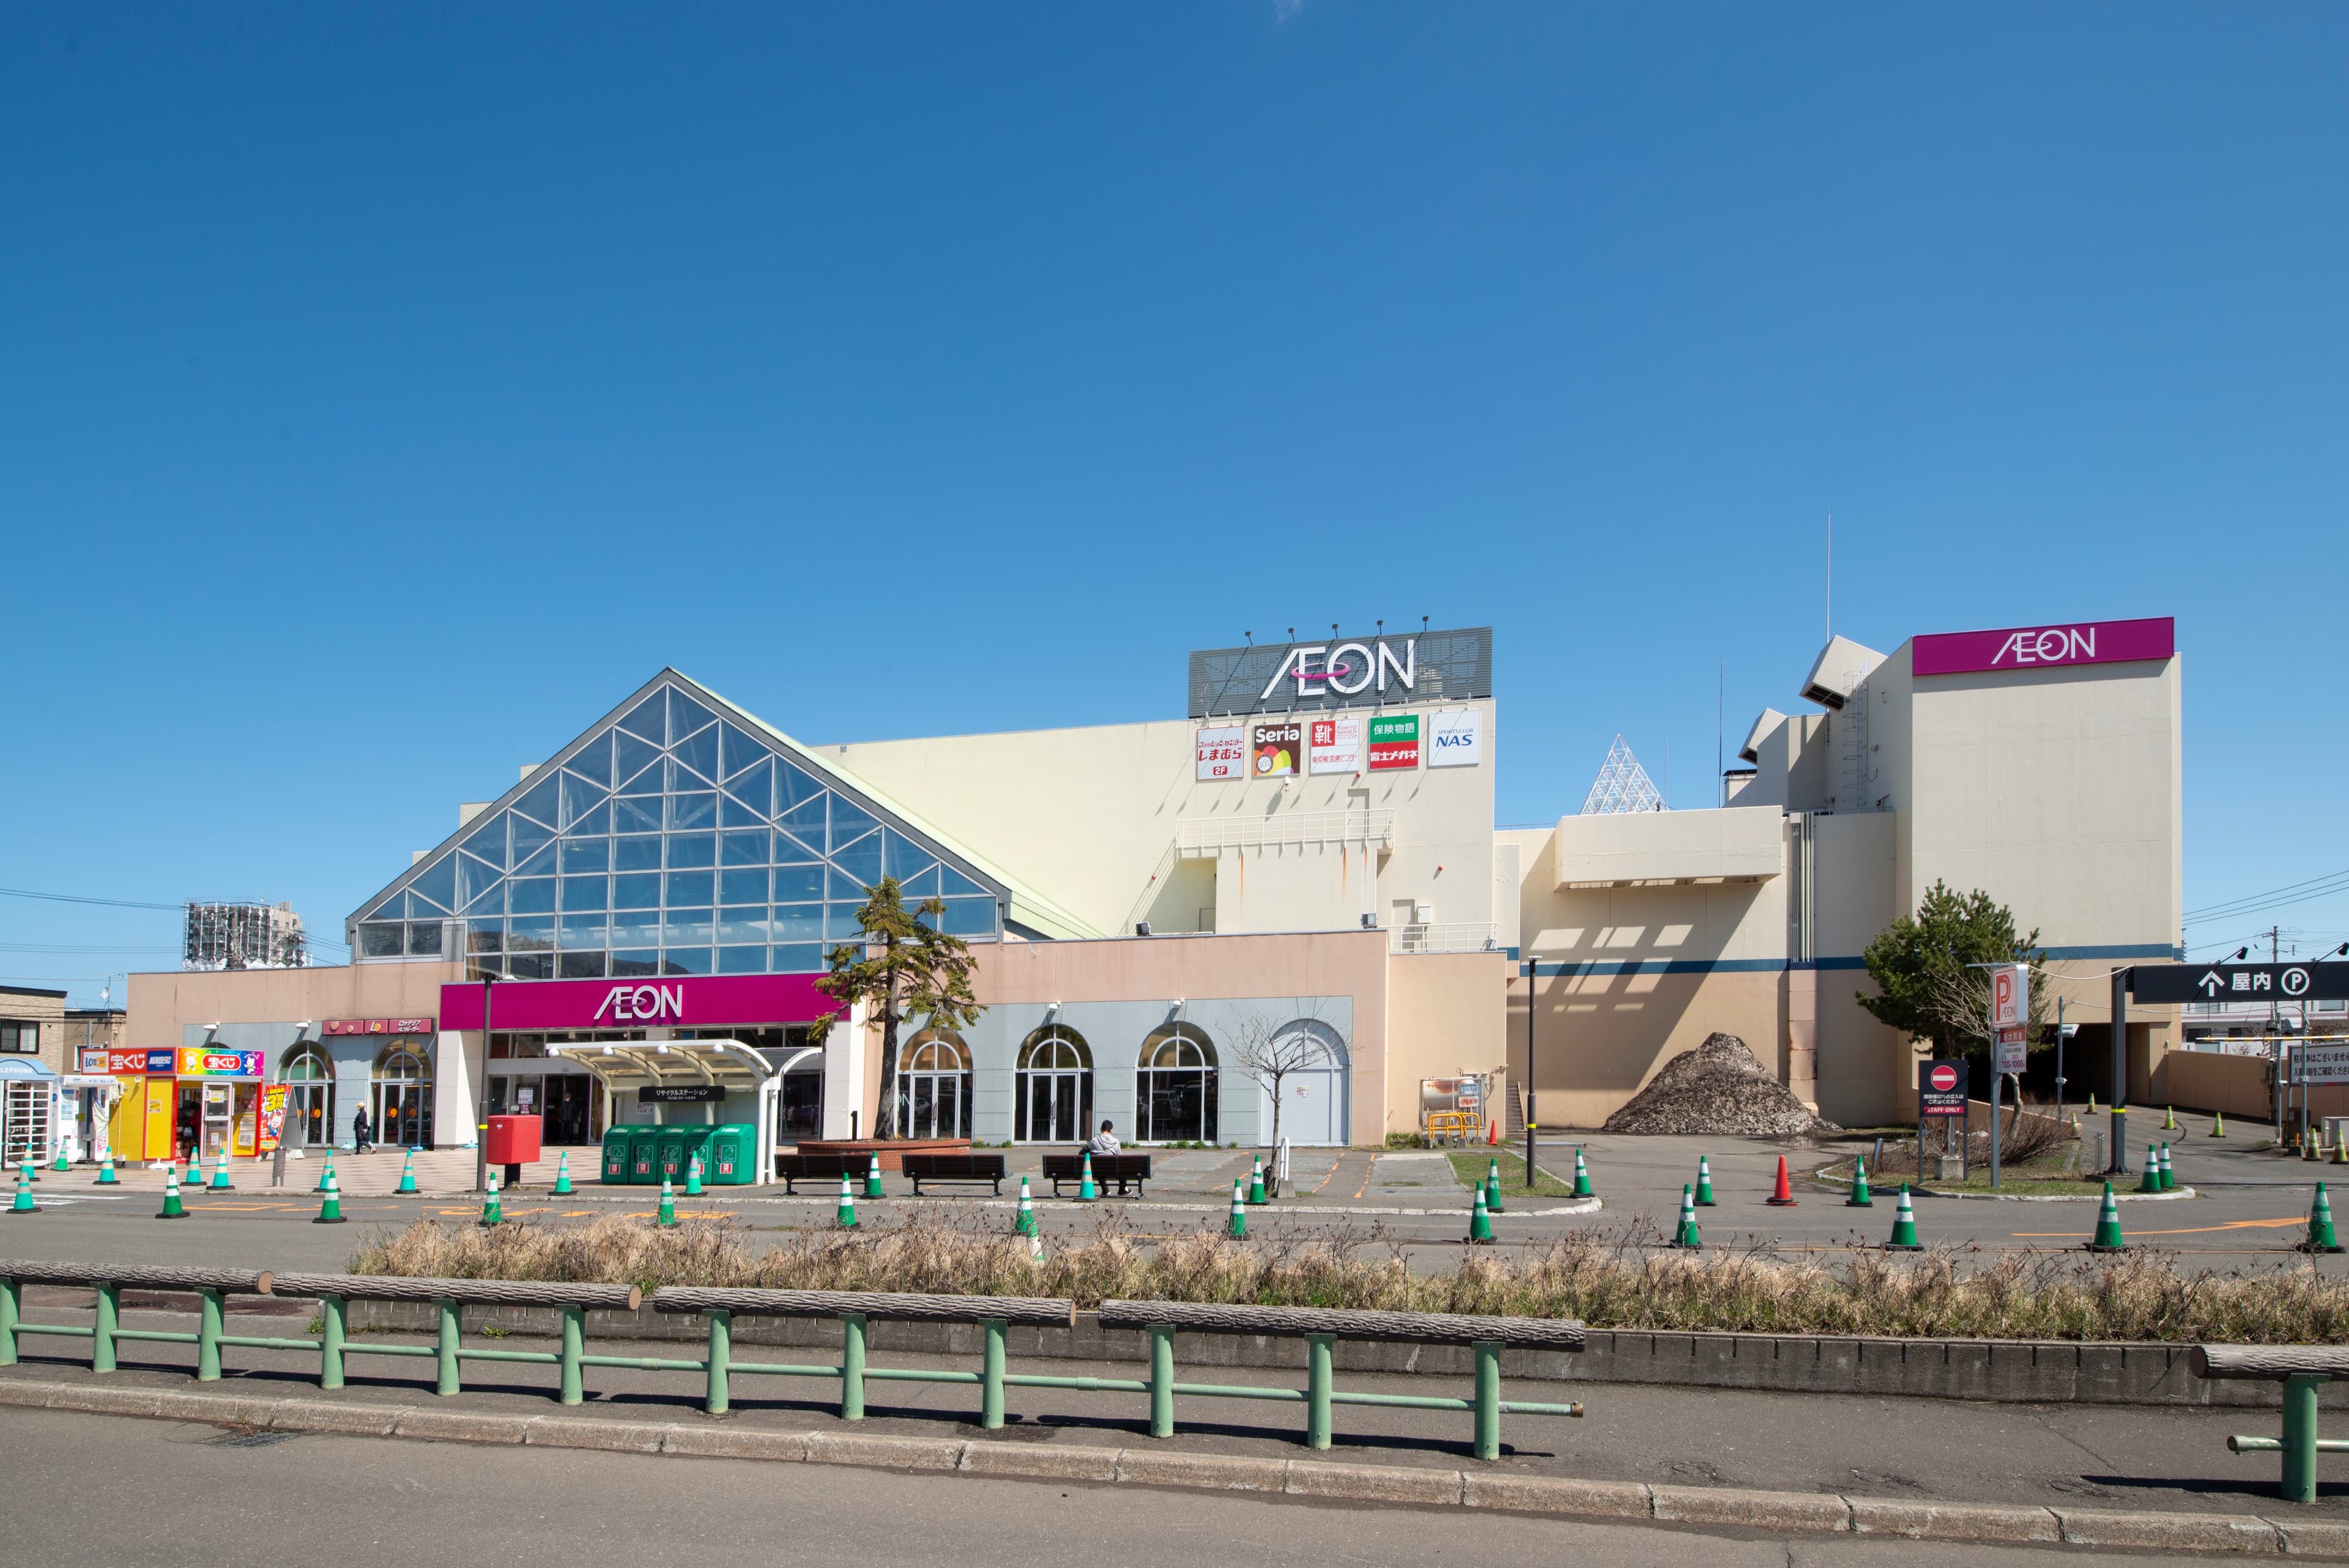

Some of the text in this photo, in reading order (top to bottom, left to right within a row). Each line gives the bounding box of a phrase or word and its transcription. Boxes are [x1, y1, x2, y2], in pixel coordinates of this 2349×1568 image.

[1256, 726, 1300, 743] Seria
[1315, 724, 1332, 744] 靴
[1374, 723, 1415, 735] 保険物語
[1436, 734, 1473, 748] NAS
[1198, 747, 1242, 761] しまむら
[1370, 749, 1418, 762] 富士メガネ
[2232, 972, 2271, 990] 屋内
[111, 1053, 146, 1069] 宝くじ
[209, 1057, 235, 1068] 宝くじ
